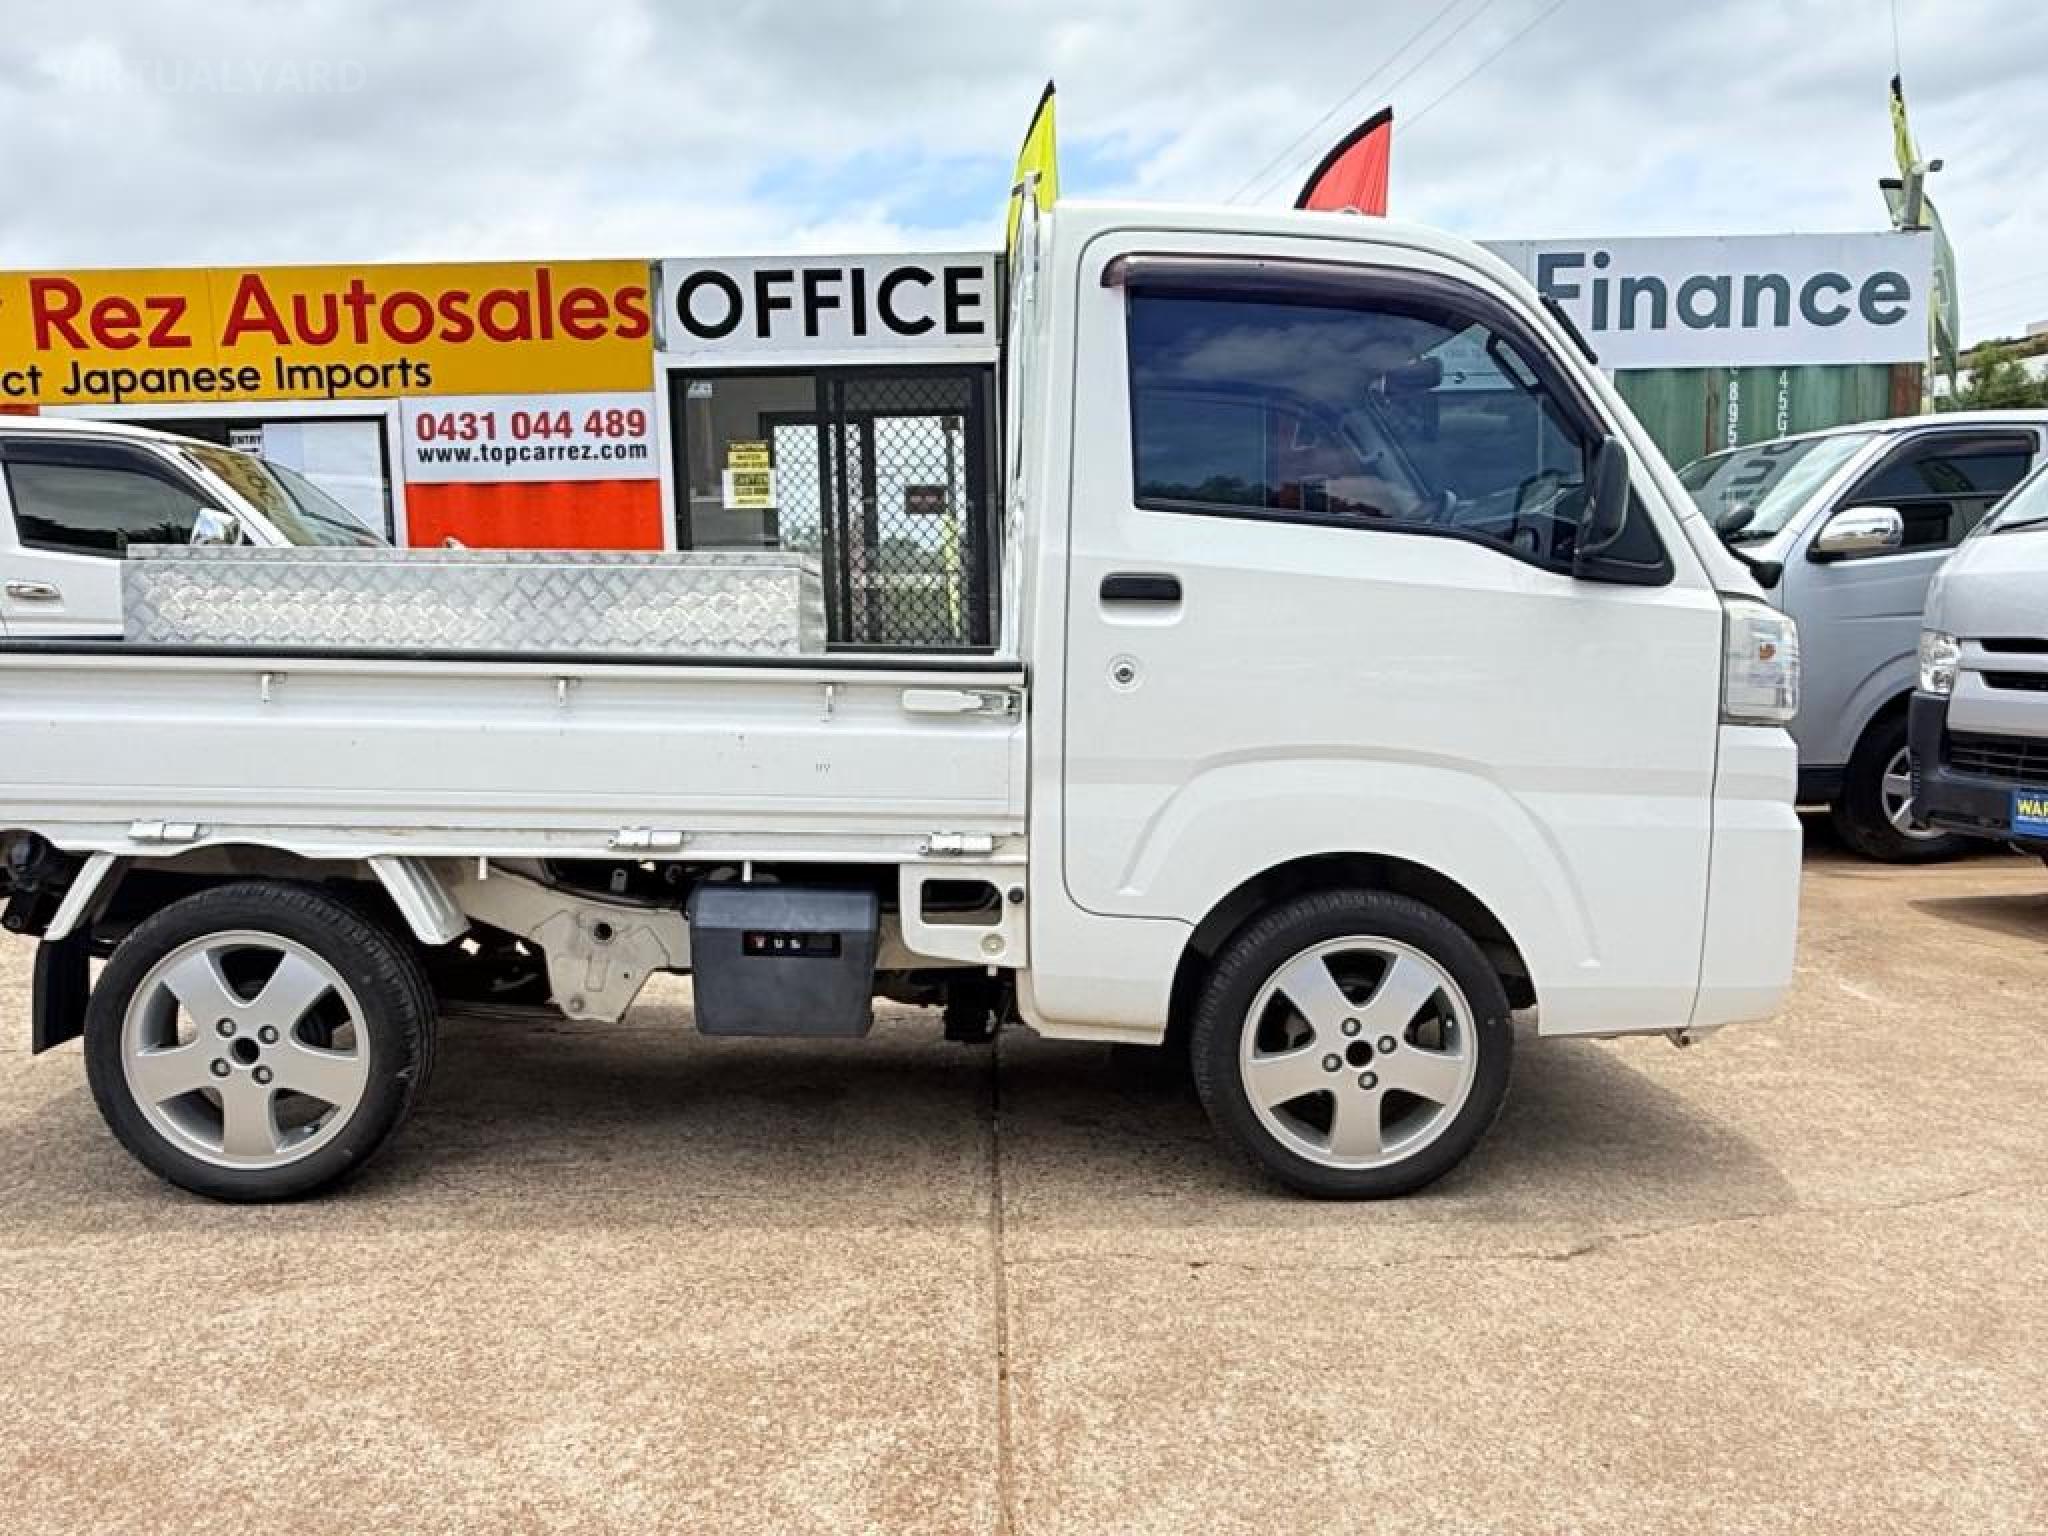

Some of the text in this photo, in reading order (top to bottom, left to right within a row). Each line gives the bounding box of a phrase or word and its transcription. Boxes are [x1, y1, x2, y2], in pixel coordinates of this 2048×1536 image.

[30, 267, 650, 350] Rez Autosales
[676, 266, 985, 339] OFFICE
[1537, 251, 1911, 331] Finance
[62, 360, 261, 403] Japanese
[275, 356, 432, 399] Imports
[416, 408, 646, 440] 0431 044 489
[417, 443, 648, 466] www.topcarrez.com
